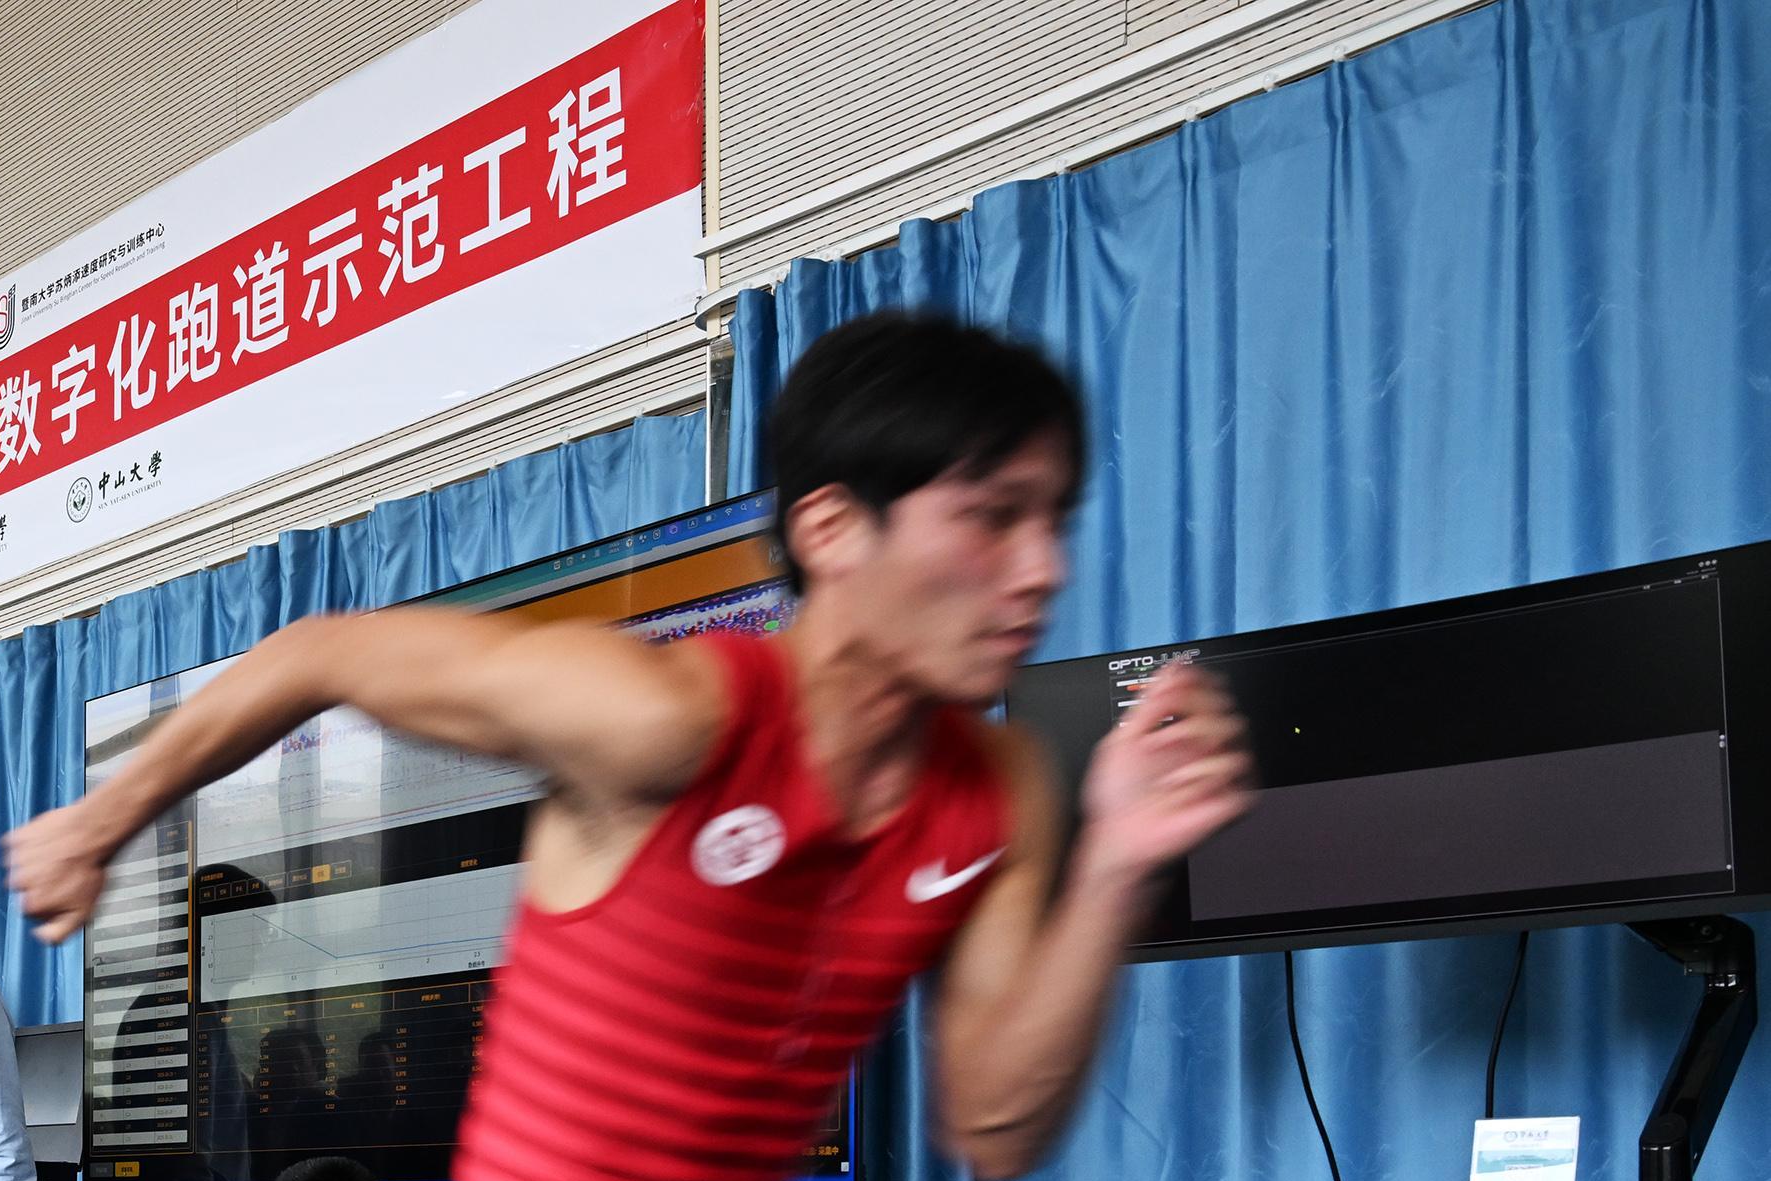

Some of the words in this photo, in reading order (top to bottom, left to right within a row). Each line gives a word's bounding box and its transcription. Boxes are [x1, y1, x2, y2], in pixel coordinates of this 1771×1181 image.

[21, 223, 165, 313] 暨南大学苏炳添速度研究与训练中心
